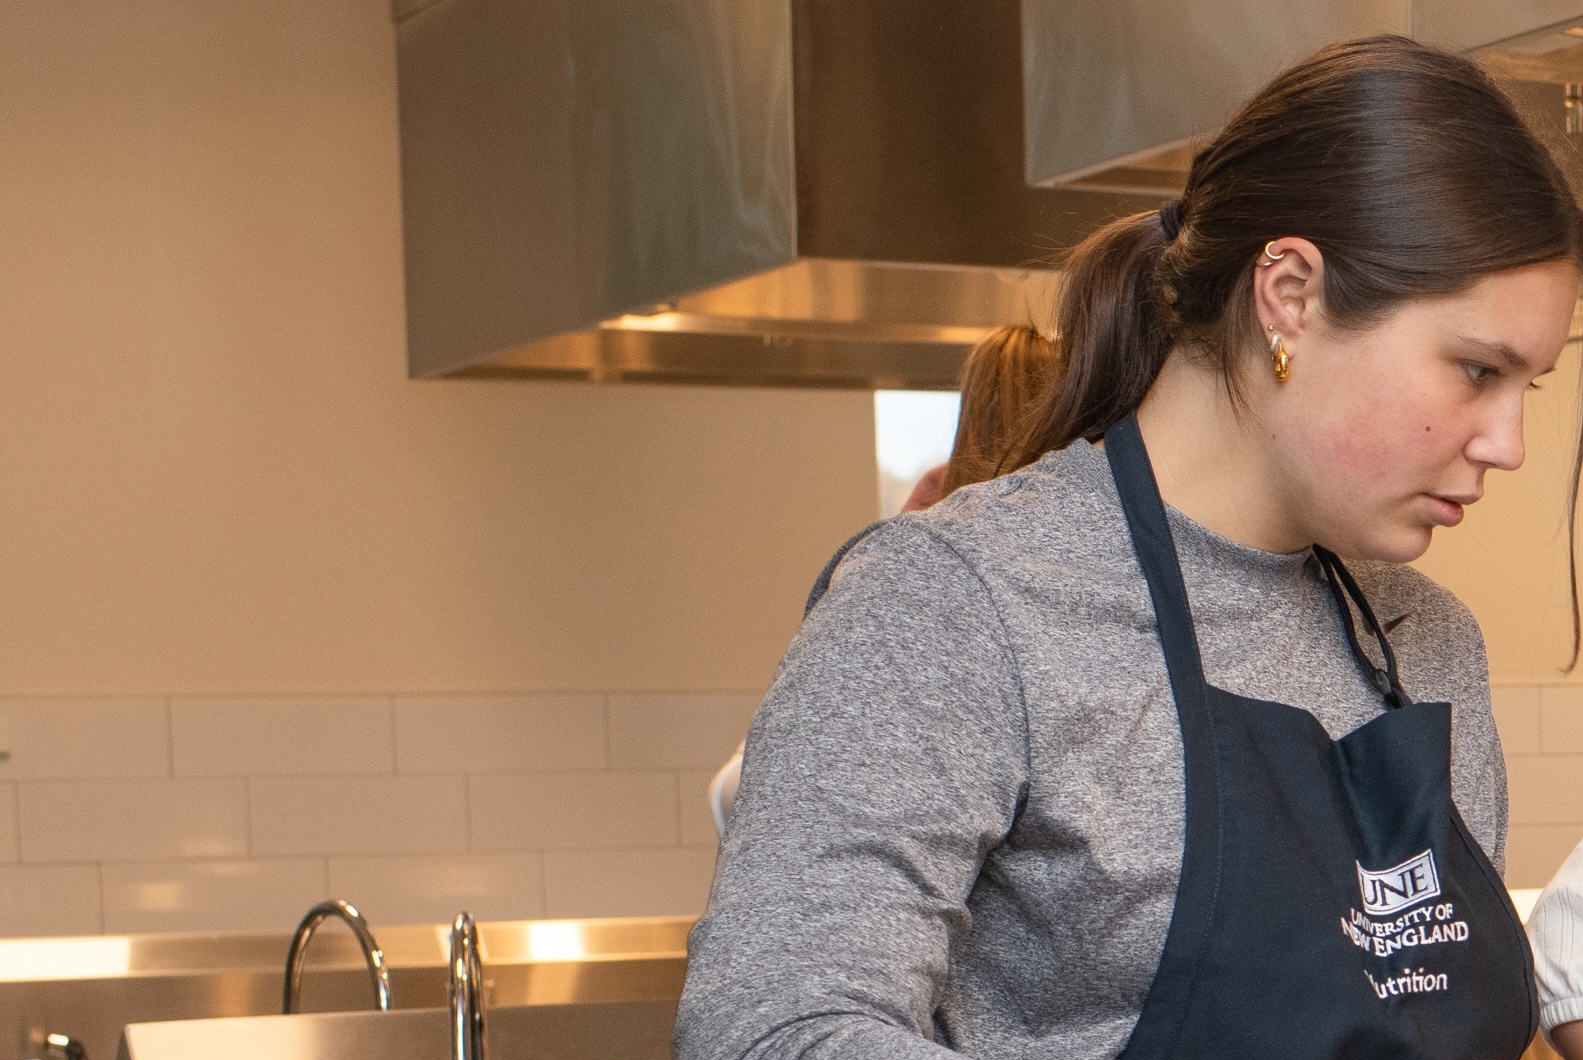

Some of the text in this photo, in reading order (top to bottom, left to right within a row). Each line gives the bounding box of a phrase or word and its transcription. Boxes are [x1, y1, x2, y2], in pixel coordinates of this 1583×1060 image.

[1435, 903, 1454, 921] OF
[1340, 917, 1469, 957] NEW ENGLAND
